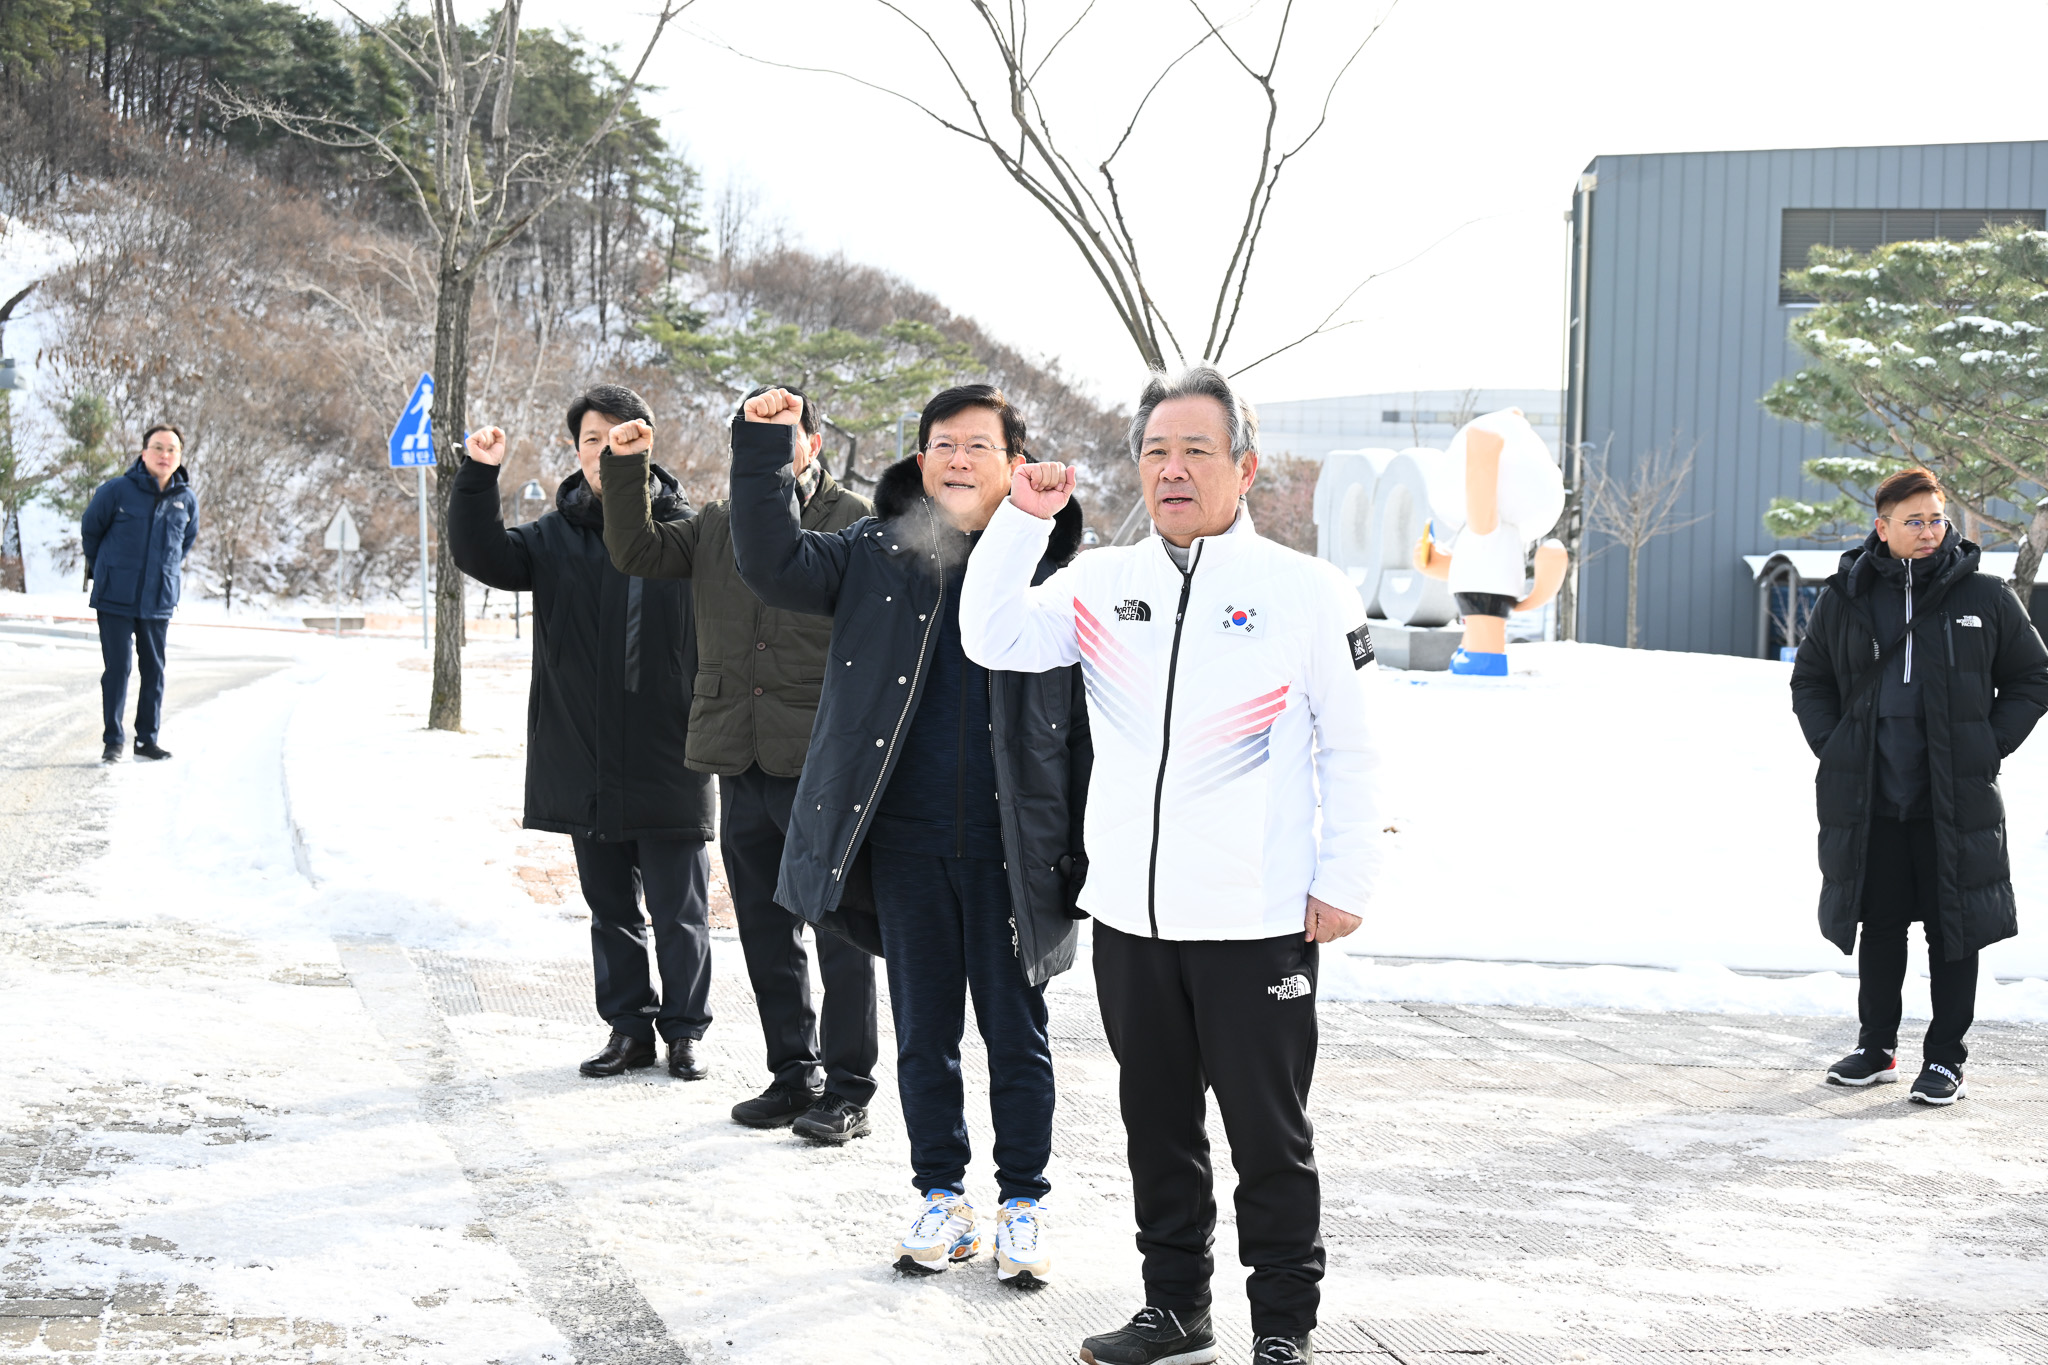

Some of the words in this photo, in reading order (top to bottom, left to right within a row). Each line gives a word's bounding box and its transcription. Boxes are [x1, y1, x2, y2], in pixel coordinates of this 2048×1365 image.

[401, 450, 436, 465] 횡단
[1123, 599, 1138, 607] THE
[1118, 613, 1135, 621] FACE
[1281, 976, 1297, 986] THE
[1267, 983, 1297, 994] NORTH
[1277, 991, 1298, 1001] FACE
